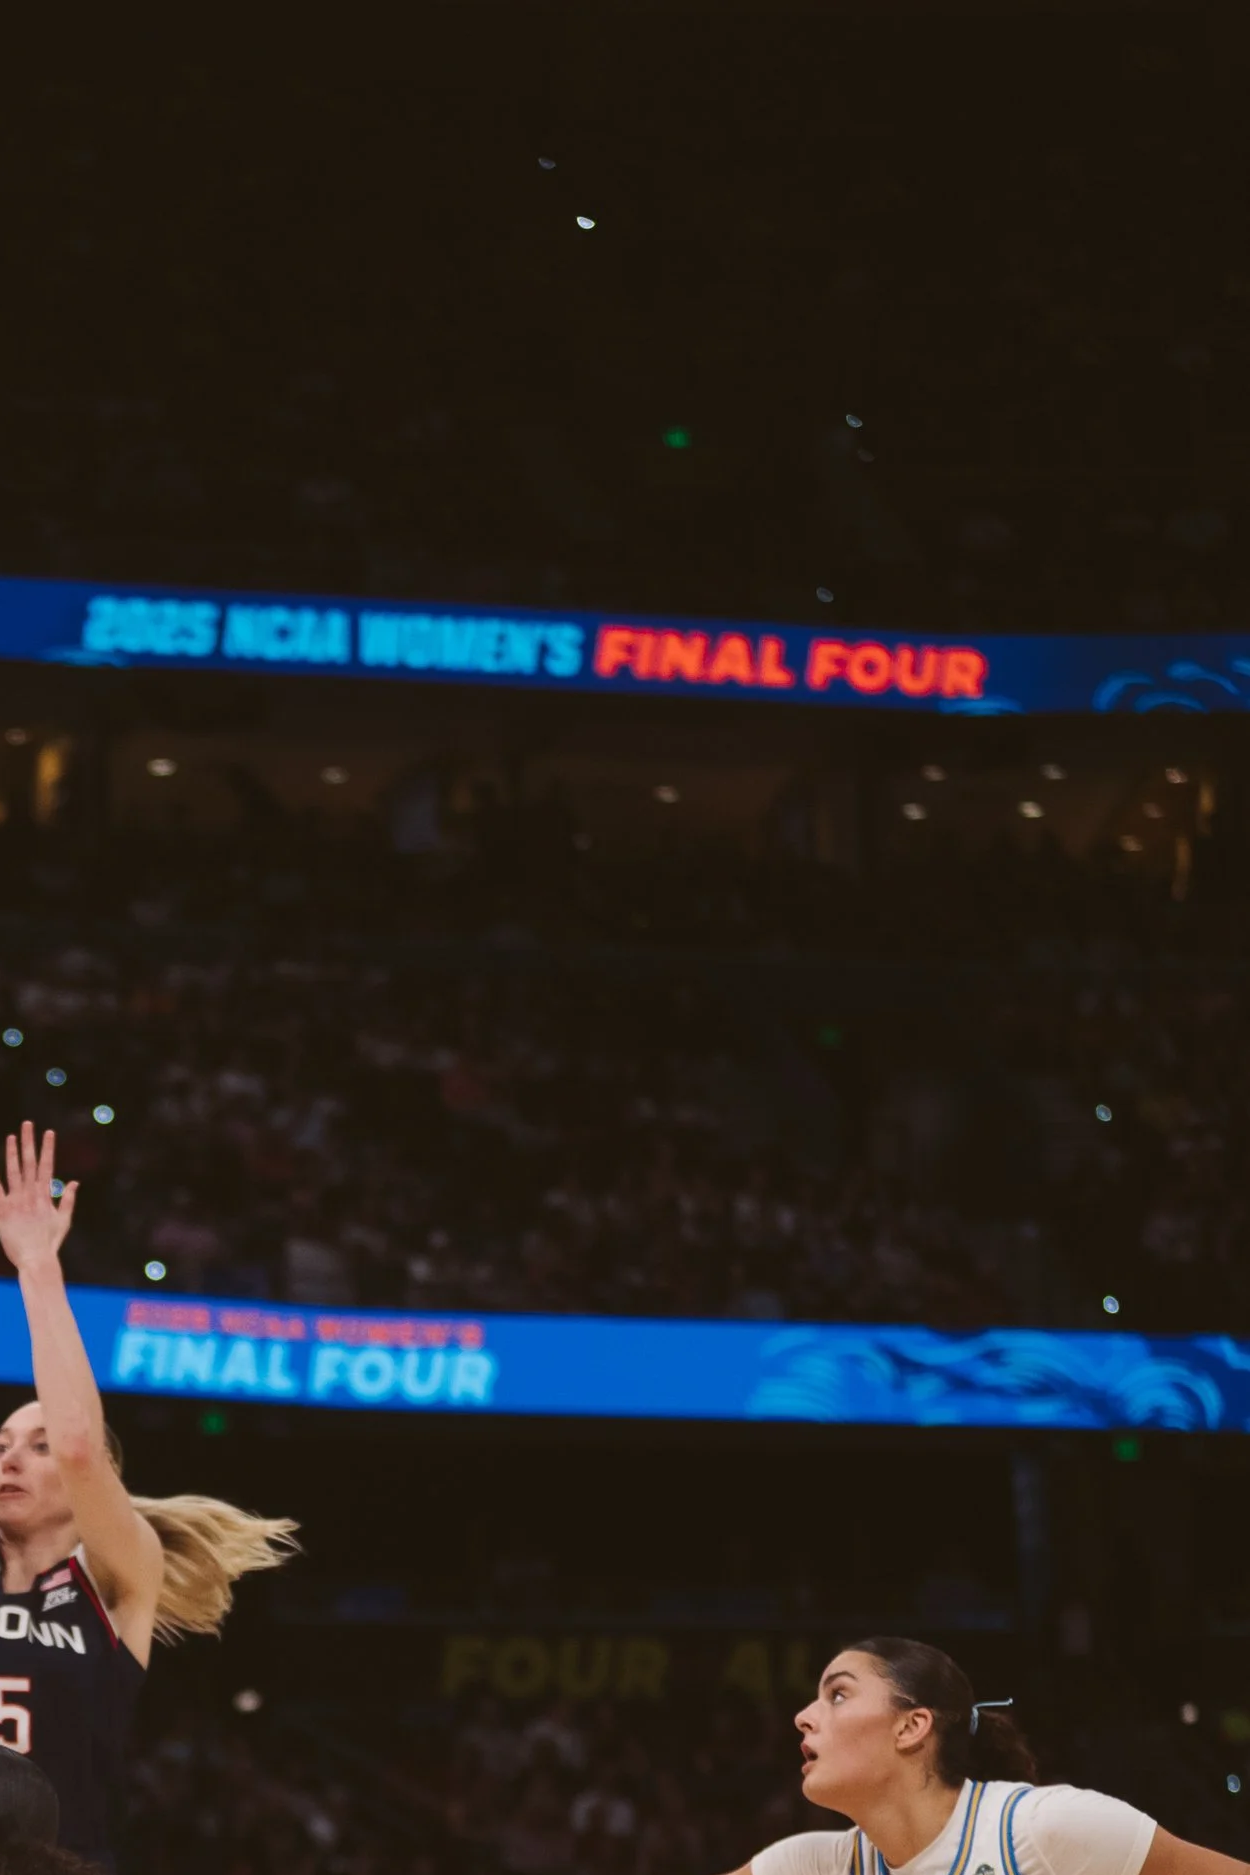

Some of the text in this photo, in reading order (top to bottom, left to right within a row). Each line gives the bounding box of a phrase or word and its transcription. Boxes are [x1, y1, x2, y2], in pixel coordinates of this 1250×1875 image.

[223, 603, 350, 664] NCAA
[358, 610, 586, 677] WOMEN'S
[593, 624, 796, 688] FINAL
[805, 638, 988, 699] FOUR
[113, 1327, 499, 1406] FINAL FOUR
[720, 1638, 823, 1698] AL
